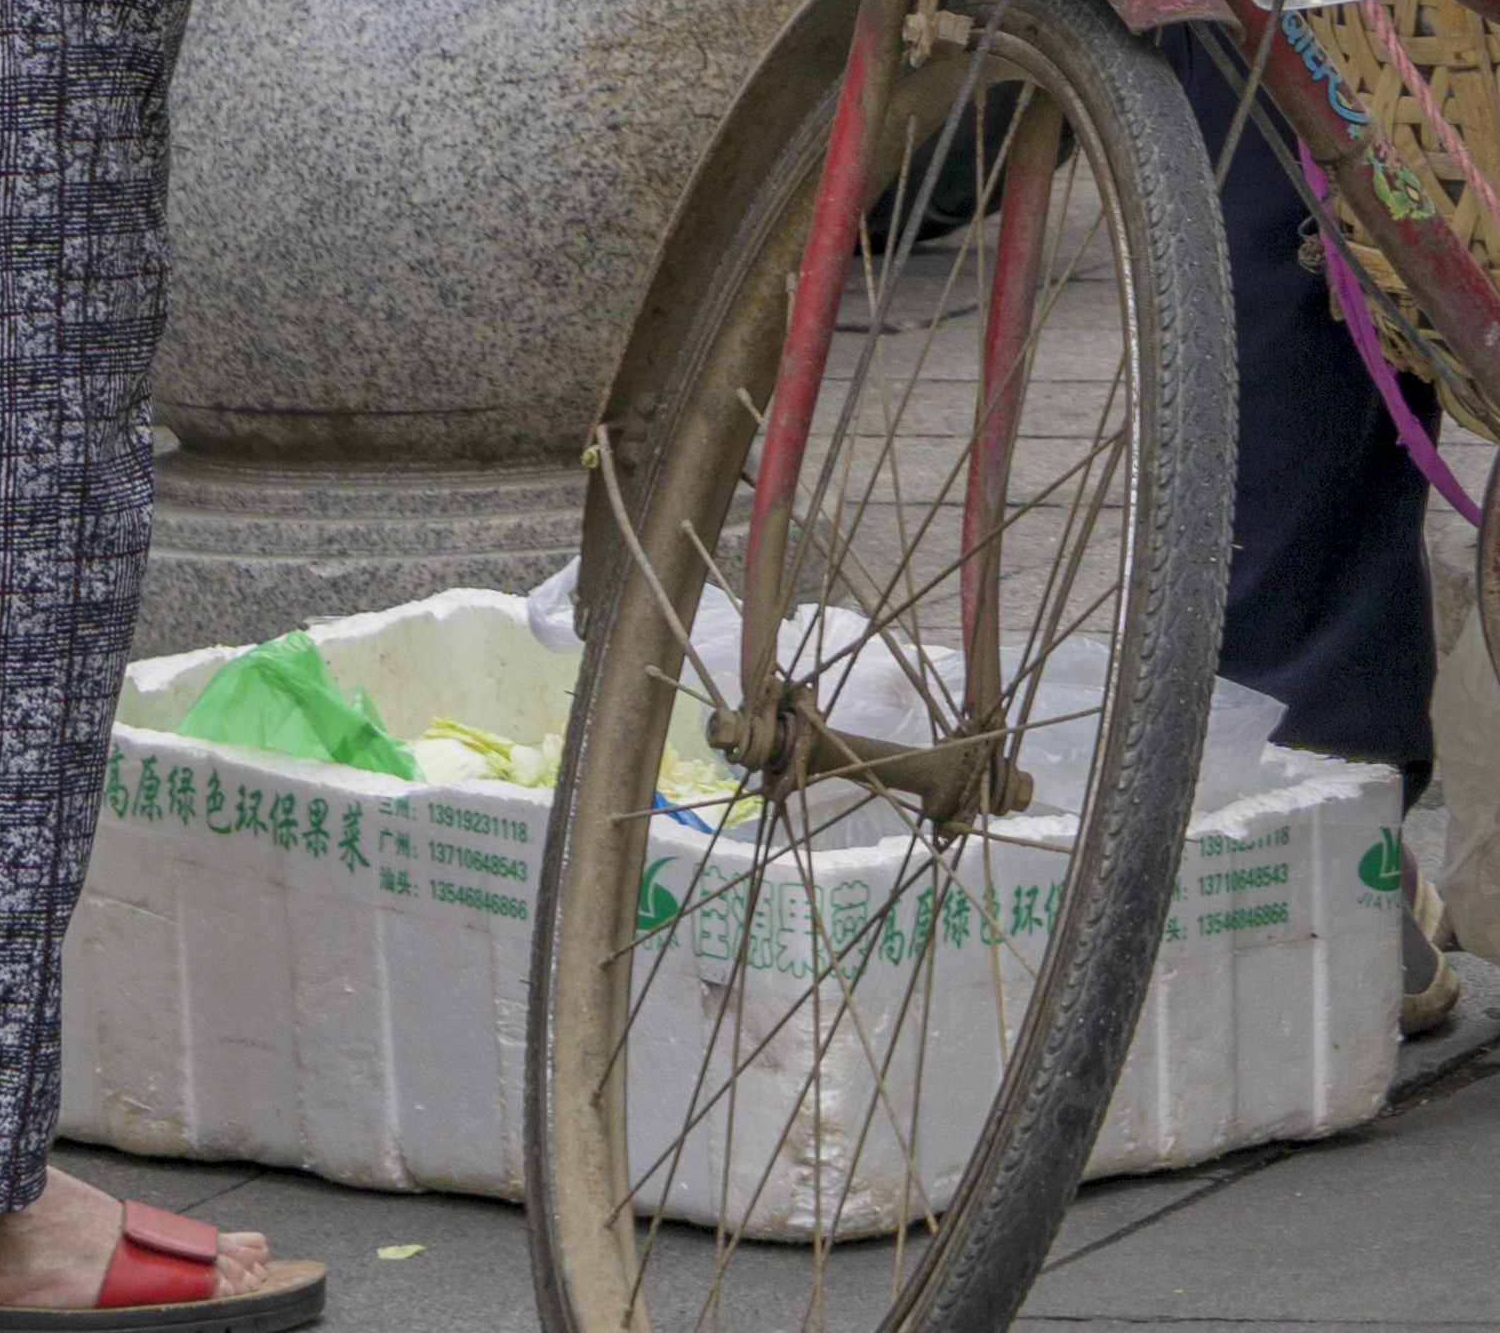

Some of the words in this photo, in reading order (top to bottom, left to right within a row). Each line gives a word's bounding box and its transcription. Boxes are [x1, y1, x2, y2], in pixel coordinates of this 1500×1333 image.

[103, 742, 371, 874] 高原绿色环保果菜
[428, 802, 529, 844] 13919231118
[428, 841, 529, 883] 13710648543
[428, 879, 529, 921] 13546846866
